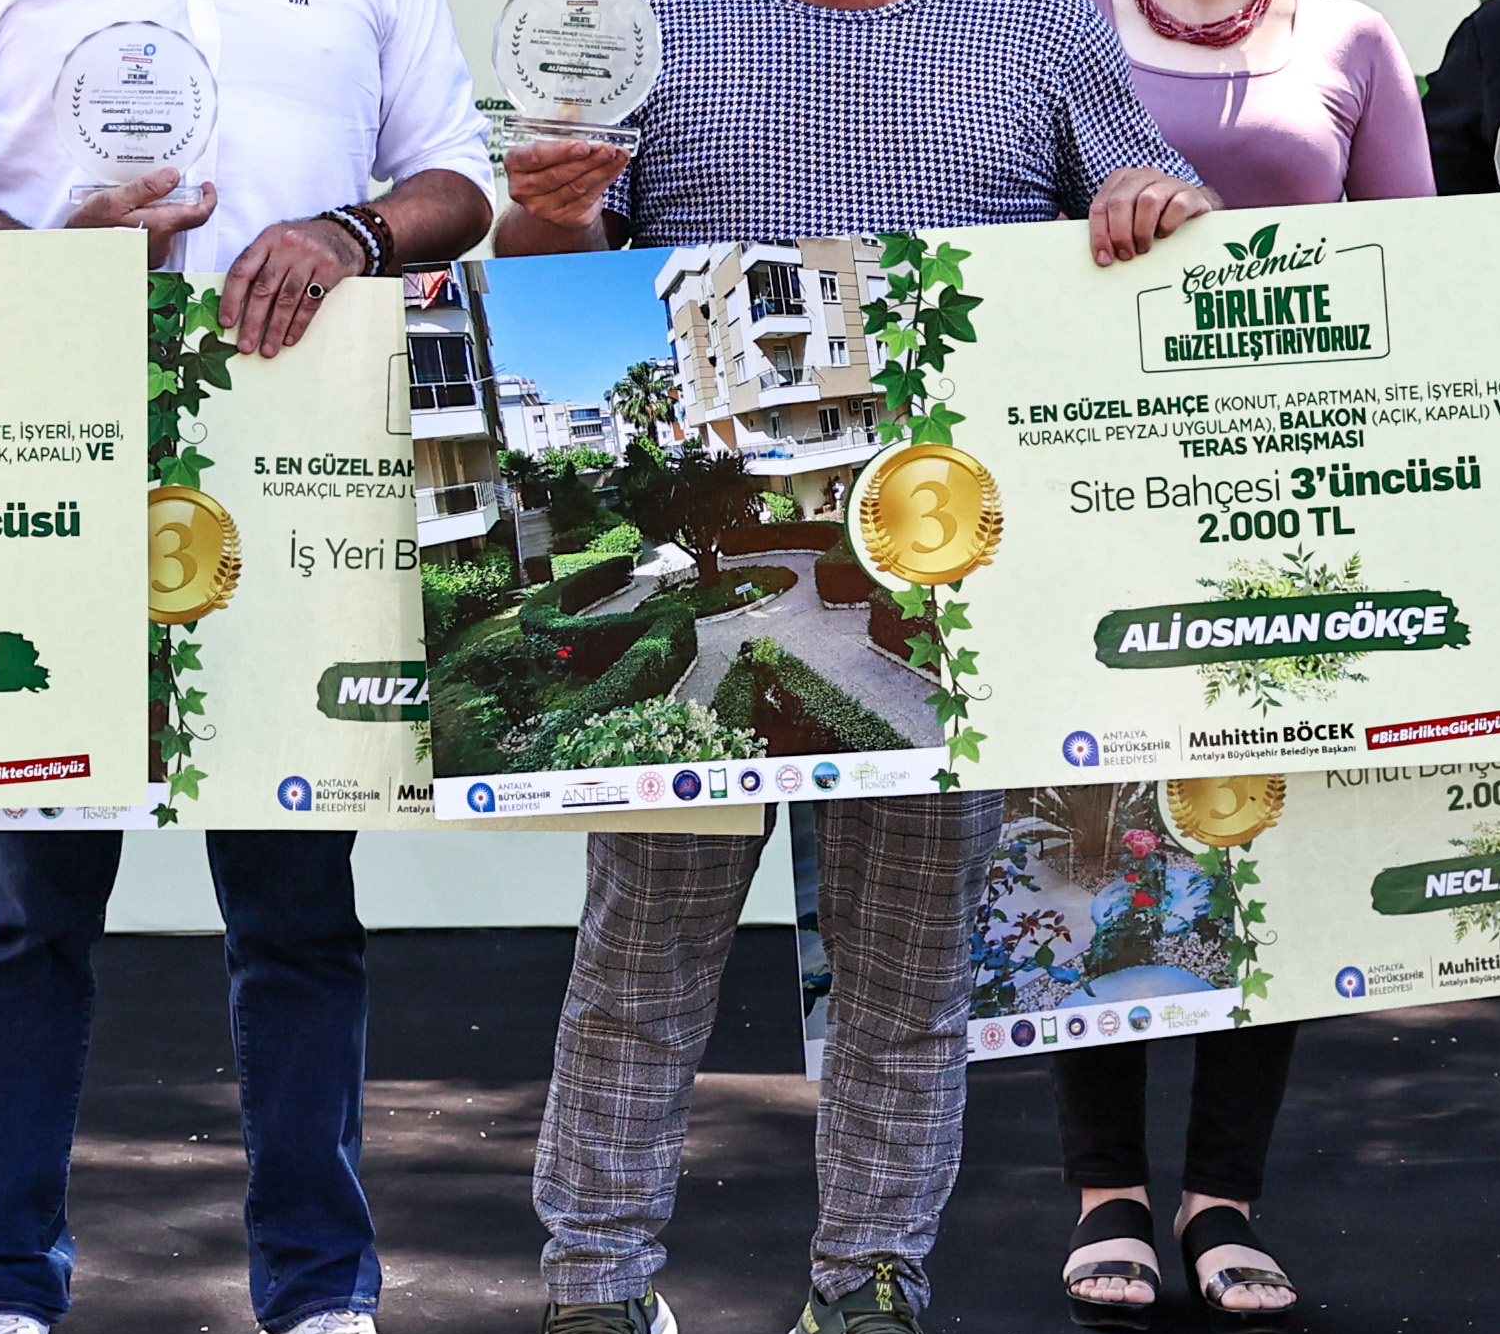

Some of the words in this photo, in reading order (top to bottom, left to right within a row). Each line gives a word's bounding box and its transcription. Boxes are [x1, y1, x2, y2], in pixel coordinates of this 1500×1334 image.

[1182, 238, 1326, 303] Çevremizi
[21, 421, 74, 442] İŞYERİ,
[80, 424, 123, 440] HOBİ,
[17, 447, 81, 463] KAPALI)
[86, 443, 114, 460] VE
[254, 457, 270, 475] 5.
[275, 457, 302, 476] EN
[308, 454, 373, 476] GÜZEL
[263, 482, 341, 499] KURAKÇIL
[346, 483, 406, 499] PEYZAJ
[1071, 481, 1134, 513] Site
[1146, 470, 1280, 513] Bahçesi
[1198, 509, 1300, 543] 2.000
[1308, 506, 1355, 536] TL
[291, 530, 315, 577] İş
[326, 538, 384, 569] Yeri
[1118, 615, 1182, 655] ALİ
[1185, 611, 1322, 648] OSMAN
[1324, 601, 1448, 648] GÖKÇE
[1190, 727, 1278, 747] Muhittin
[1283, 721, 1354, 742] BÖCEK
[561, 784, 630, 804] ANTEPE
